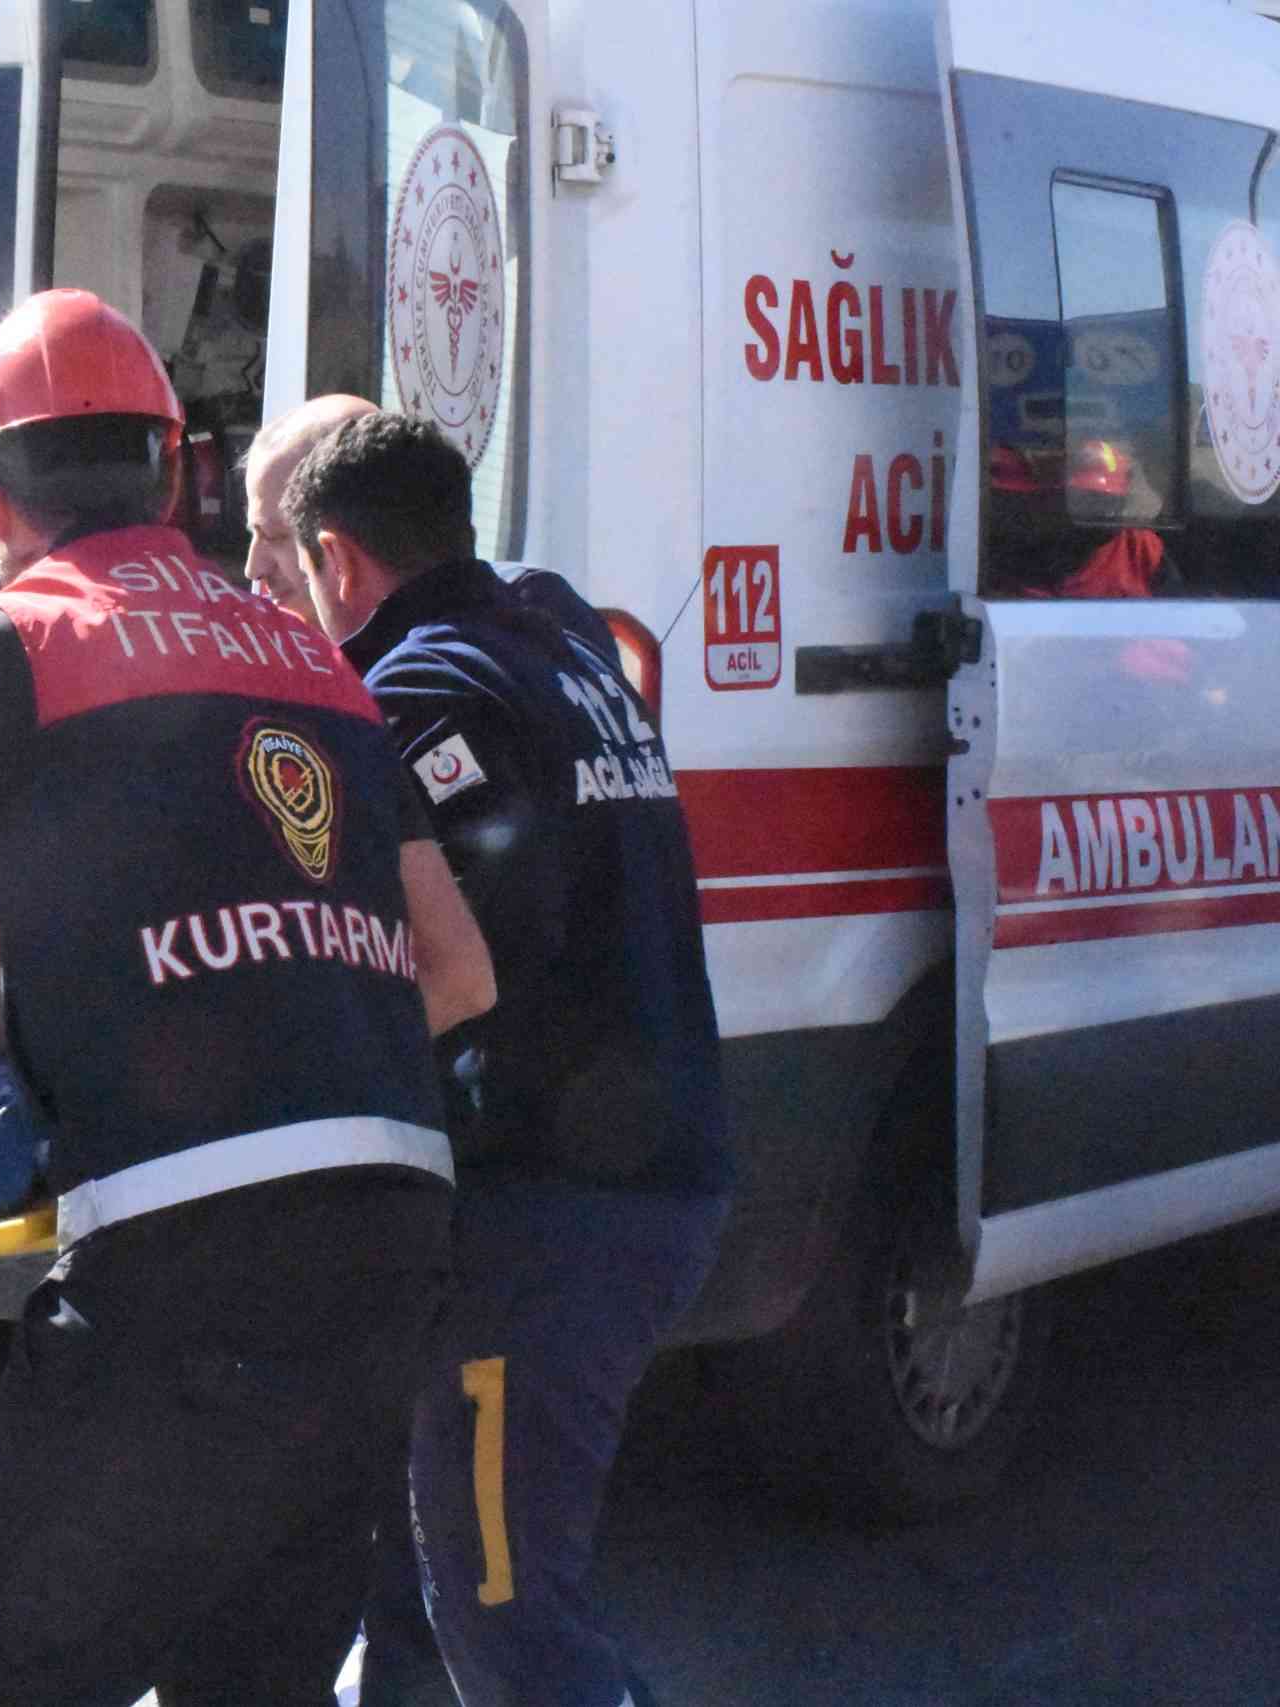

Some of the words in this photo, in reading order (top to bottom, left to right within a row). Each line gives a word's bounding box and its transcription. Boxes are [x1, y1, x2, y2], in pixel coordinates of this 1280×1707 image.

[744, 248, 961, 387] SAĞLIK
[842, 431, 956, 555] ACİ
[708, 560, 775, 636] 112
[727, 648, 763, 674] ACİL
